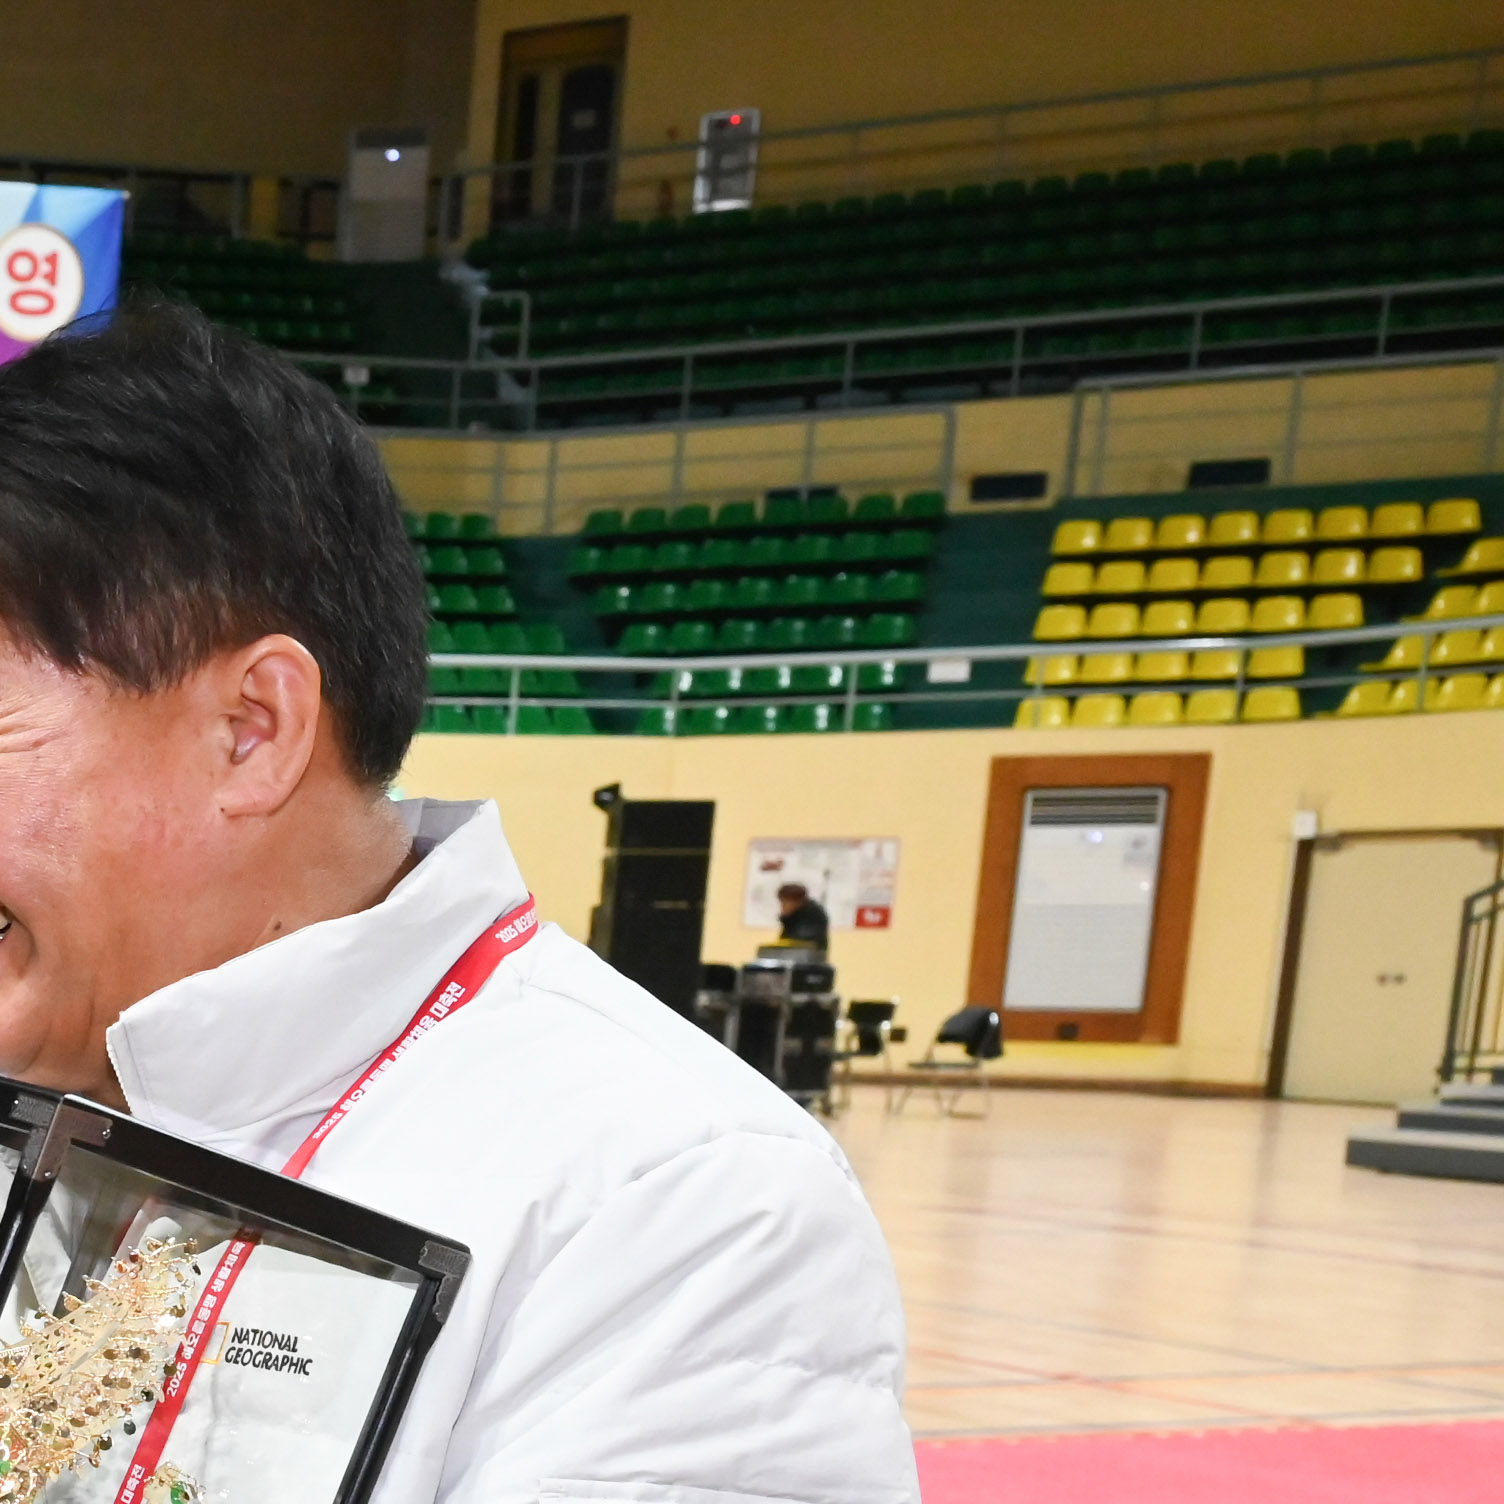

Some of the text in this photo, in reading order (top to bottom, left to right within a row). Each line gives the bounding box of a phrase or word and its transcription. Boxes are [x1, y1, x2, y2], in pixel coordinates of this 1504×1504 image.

[6, 247, 60, 318] 영
[231, 1327, 298, 1353] NATIONAL
[224, 1346, 313, 1376] GEOGRAPHIC
[166, 1361, 188, 1398] 2025
